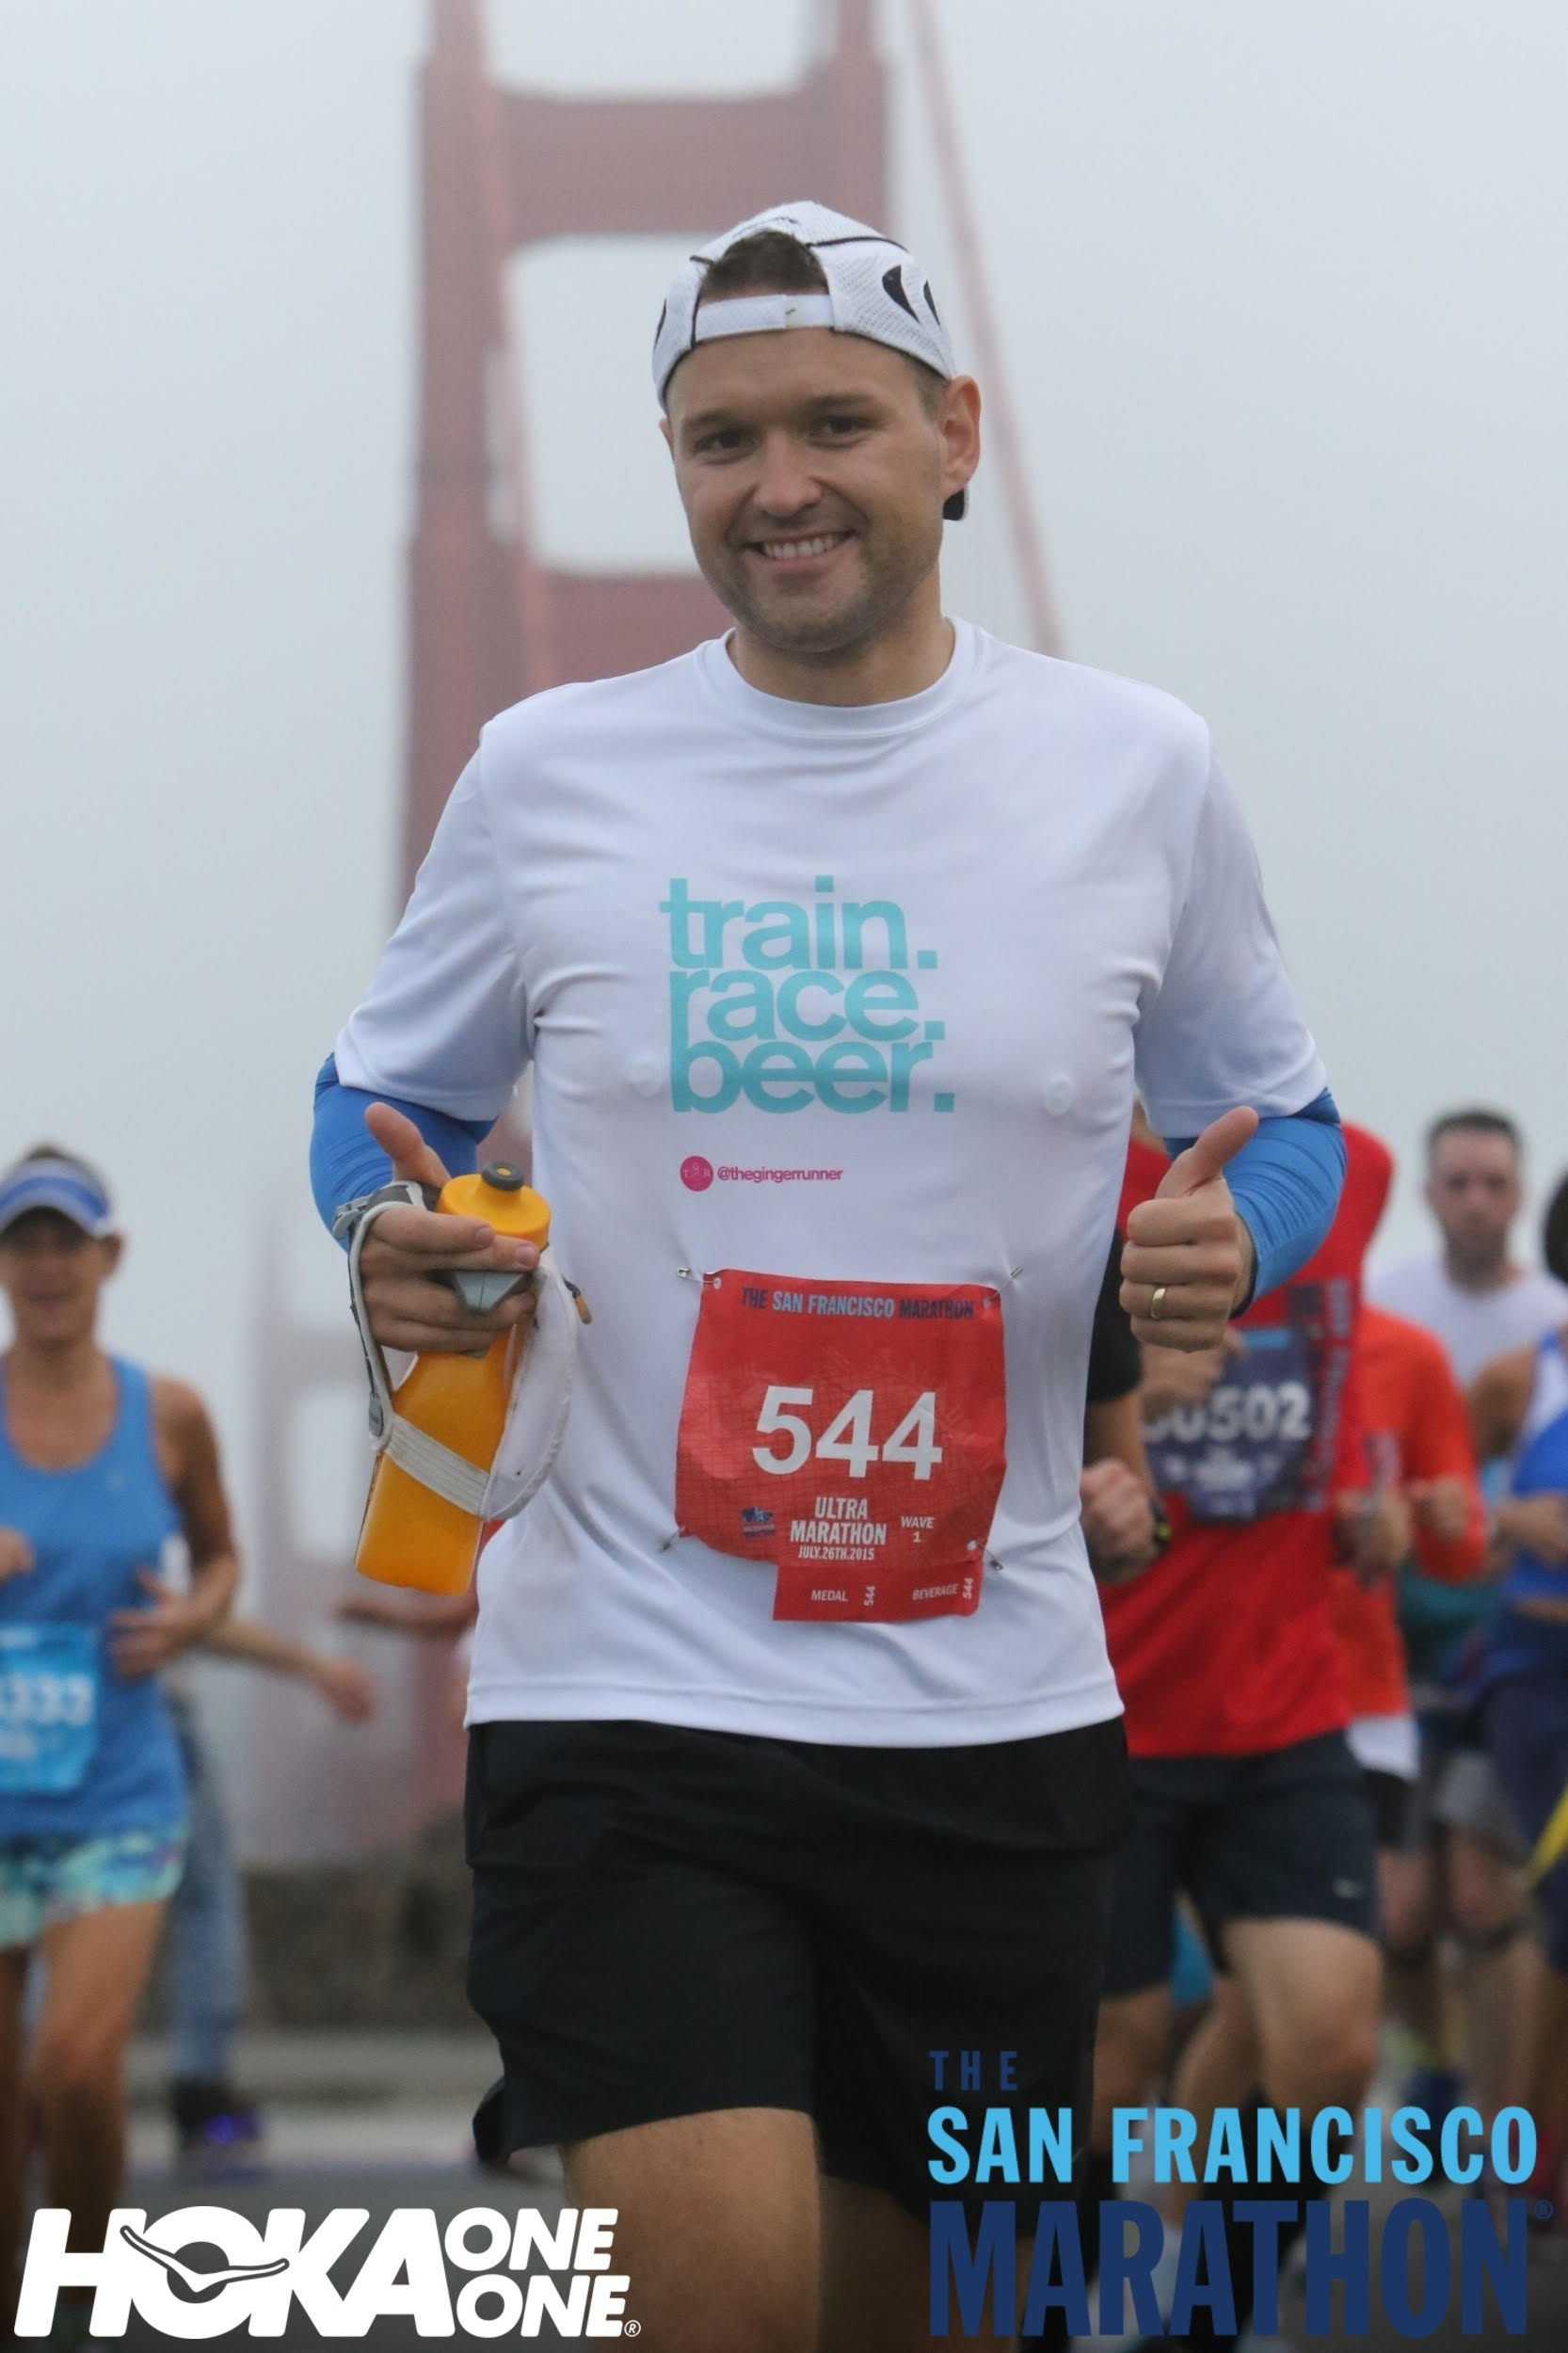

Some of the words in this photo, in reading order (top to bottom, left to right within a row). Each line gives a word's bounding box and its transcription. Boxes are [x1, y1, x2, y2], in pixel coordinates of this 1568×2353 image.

[659, 874, 938, 970] train.
[669, 969, 946, 1041] race.
[669, 1040, 956, 1114] beer.
[717, 1166, 844, 1183] @thegingerrunner
[742, 1287, 768, 1309] THE
[772, 1289, 804, 1313] SAN
[807, 1294, 895, 1318] FRANCISCO
[899, 1298, 975, 1320] MARATHON
[752, 1385, 943, 1481] 544
[814, 1497, 869, 1520] ULTRA
[790, 1520, 888, 1545] MARATHON
[901, 1516, 936, 1529] WAVE
[913, 1531, 921, 1543] 1
[810, 1590, 848, 1602] MEDAL
[863, 1585, 876, 1607] 544
[912, 1583, 959, 1601] BEVERAGE
[962, 1577, 974, 1600] 544
